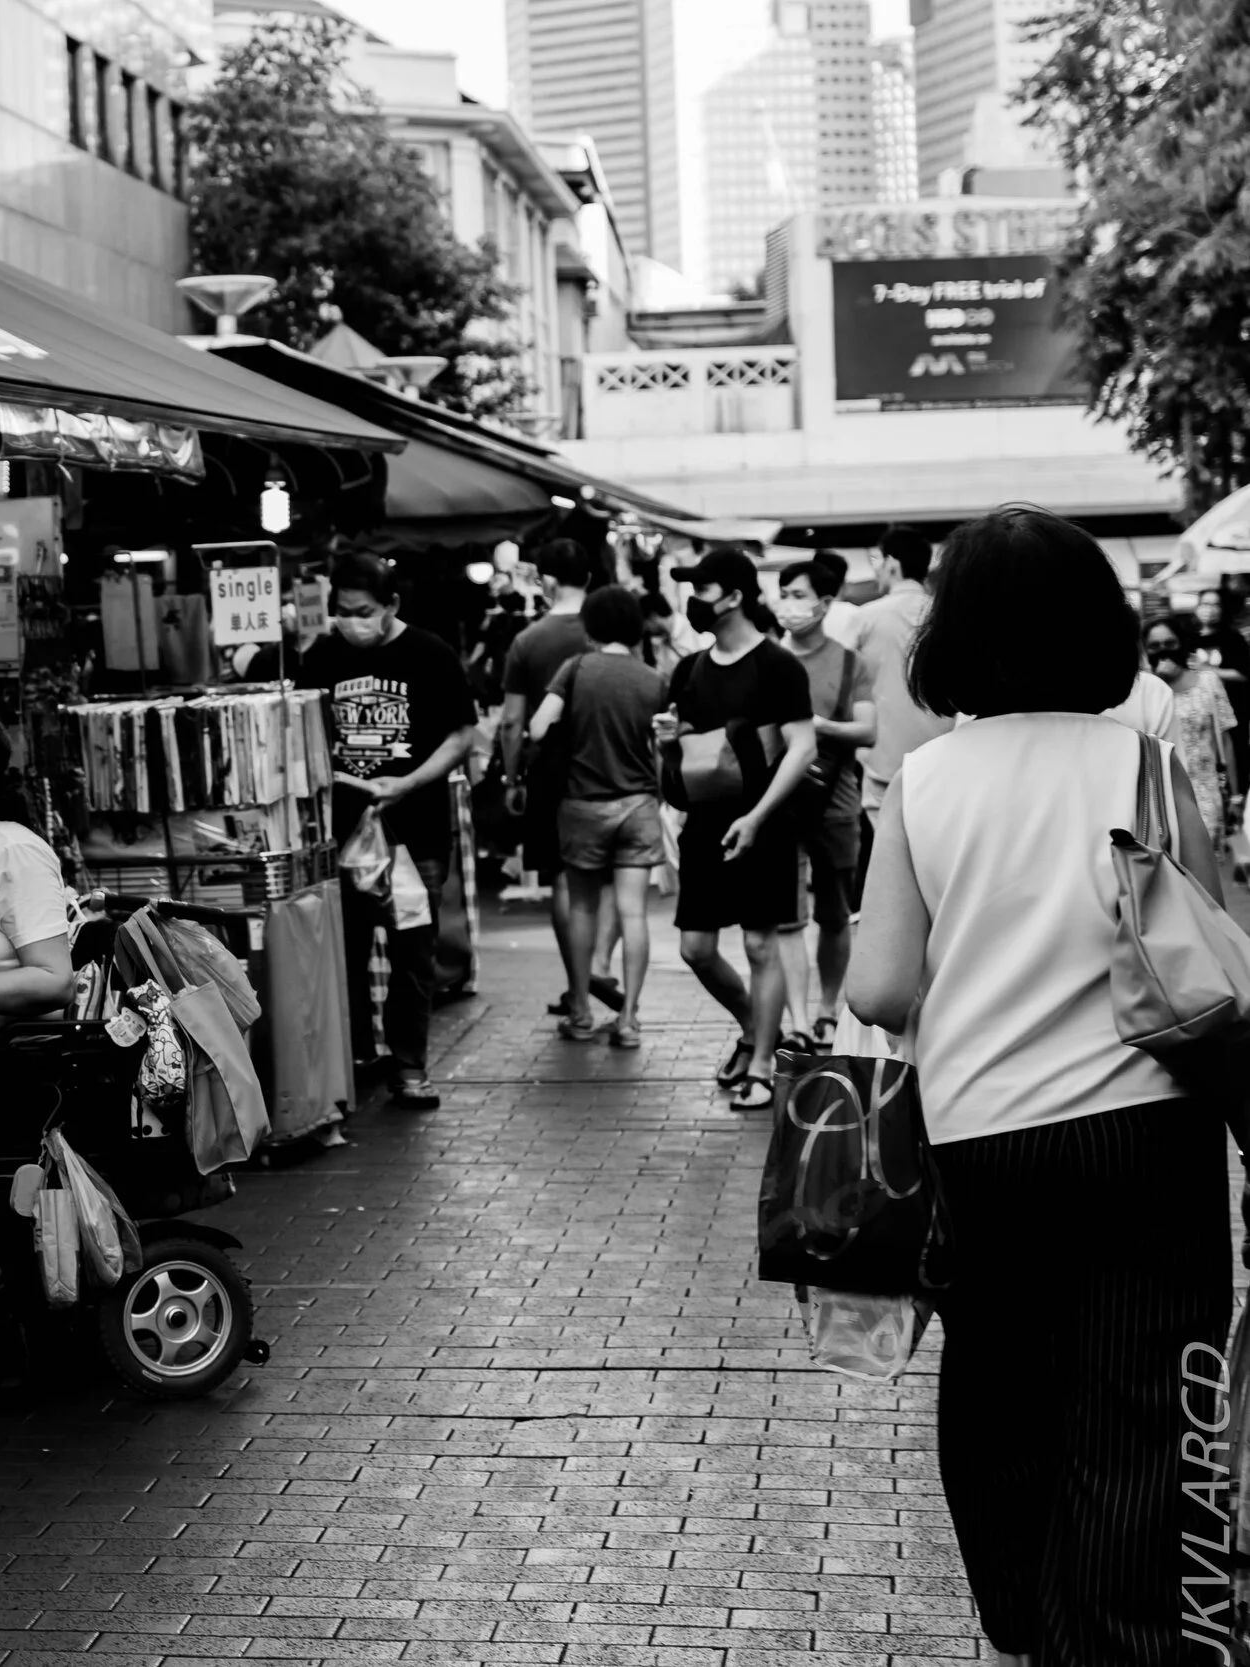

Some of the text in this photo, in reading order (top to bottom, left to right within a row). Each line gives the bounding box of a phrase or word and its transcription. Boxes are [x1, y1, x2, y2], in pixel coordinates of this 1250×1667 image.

[872, 278, 1047, 305] 7-Day FREE trial of
[217, 573, 273, 602] single
[365, 703, 411, 725] YORK
